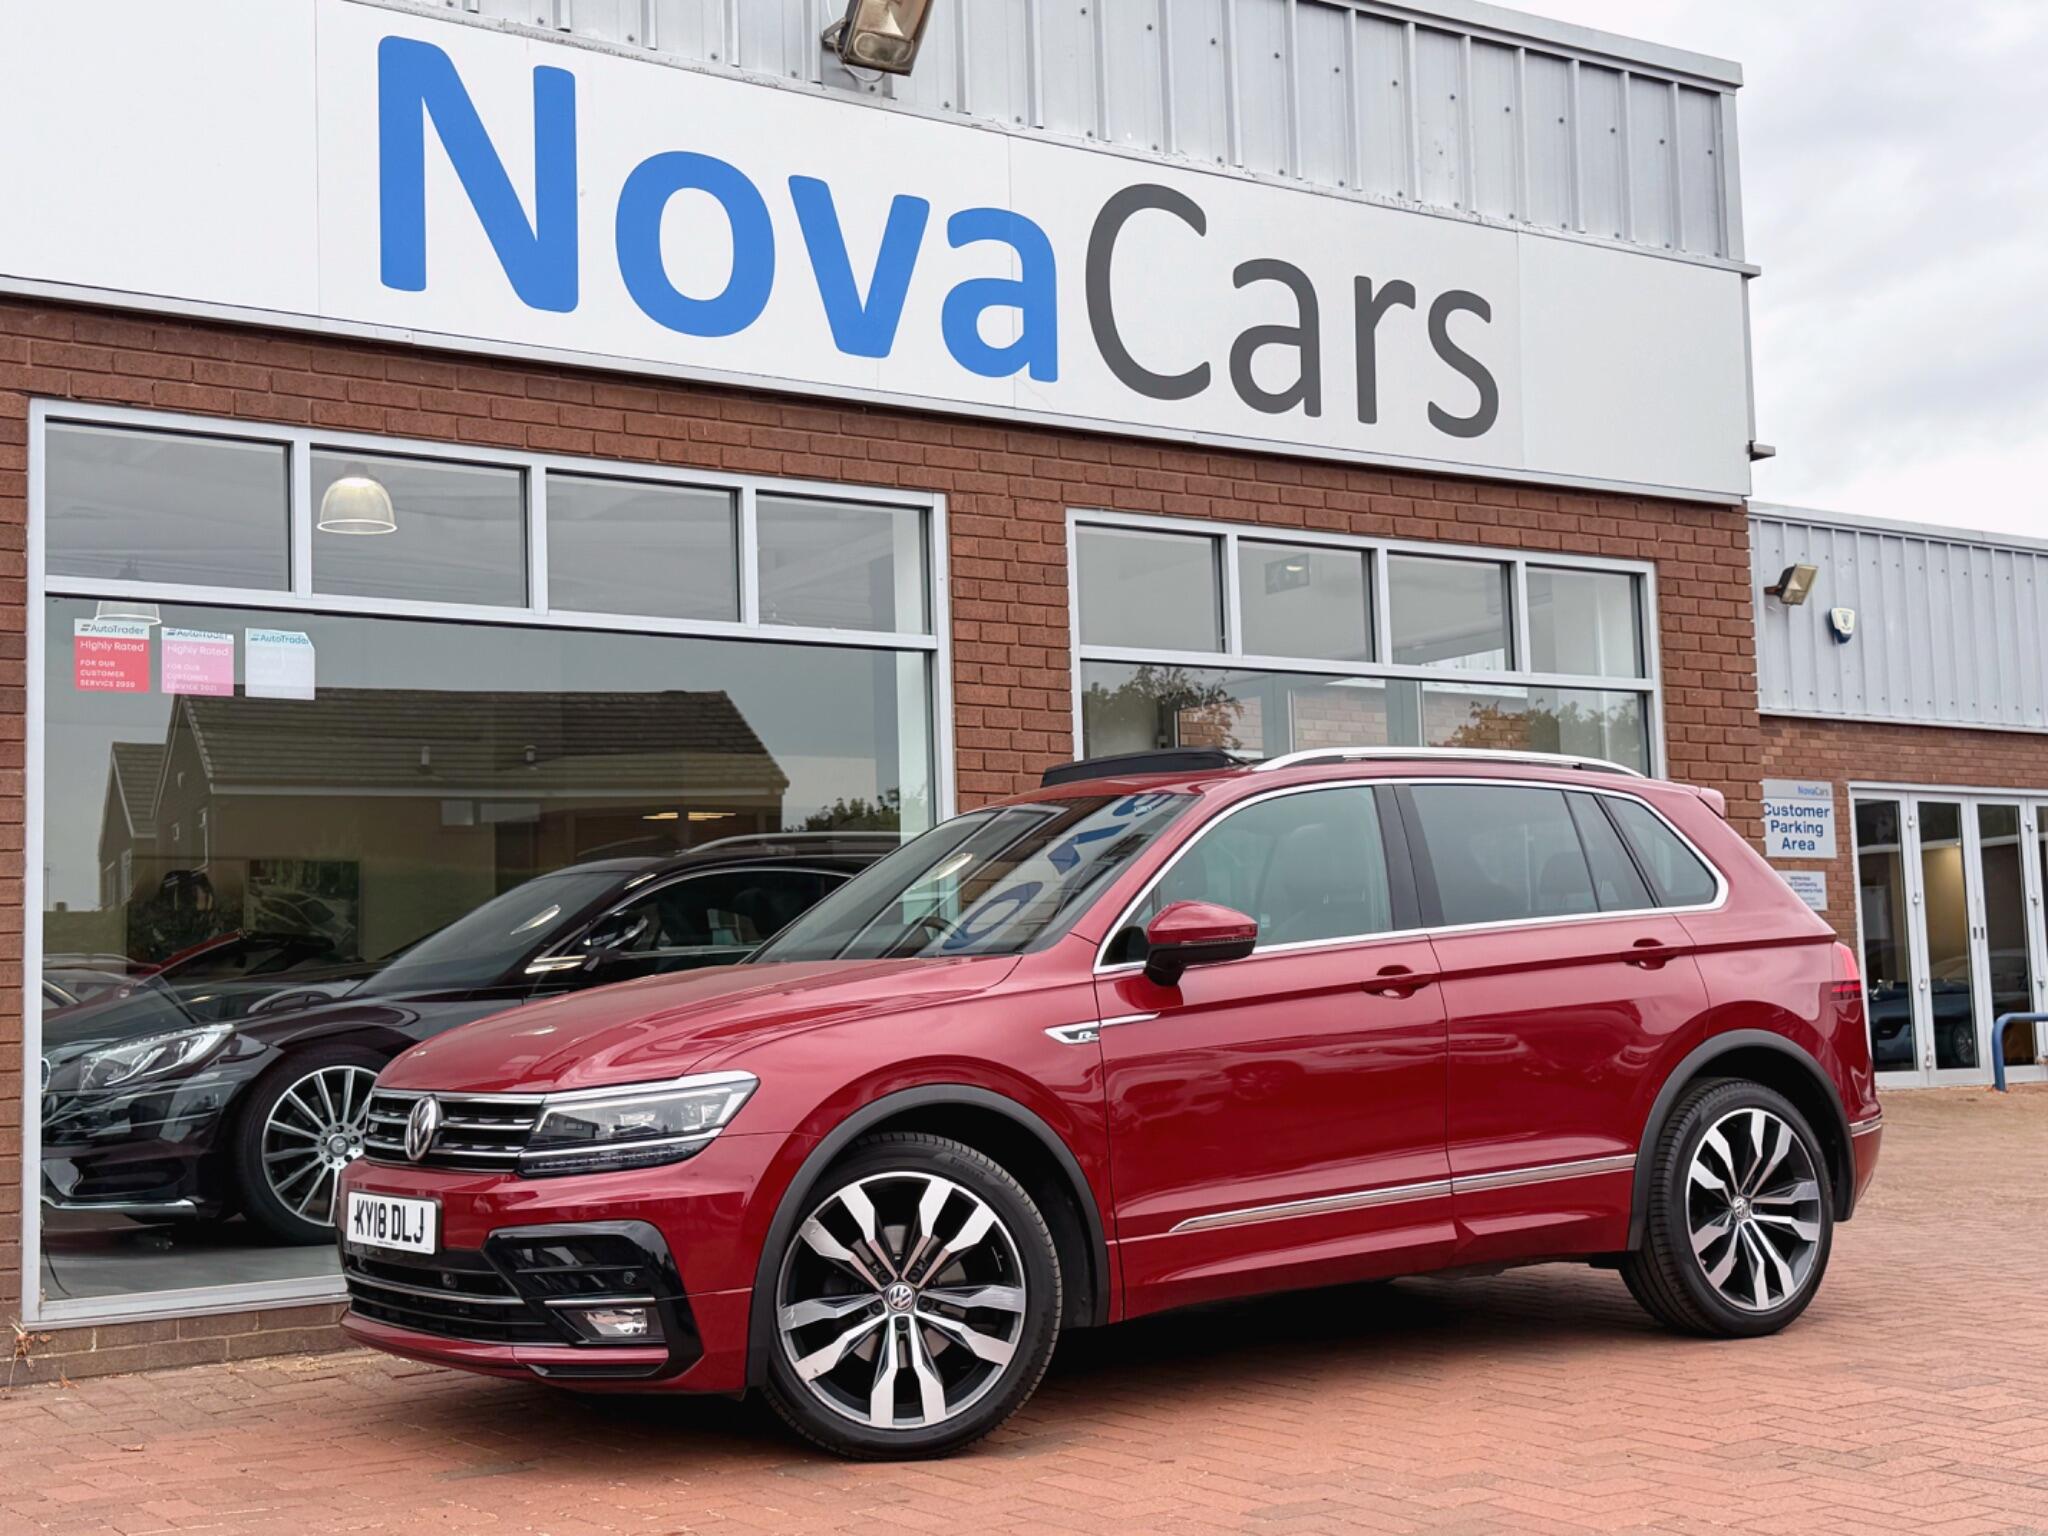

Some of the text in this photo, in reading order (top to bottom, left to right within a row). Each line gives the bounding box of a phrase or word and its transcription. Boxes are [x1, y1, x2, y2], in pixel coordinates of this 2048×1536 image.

[379, 37, 1498, 438] NovaCars
[90, 624, 145, 635] AutoTrader
[80, 639, 144, 653] Highly Rated
[80, 659, 116, 668] FOR OUR
[80, 669, 125, 678] CUSTOMER
[80, 679, 114, 688] SERVICE
[1763, 802, 1830, 818] Customer
[1770, 819, 1824, 838] Parking
[1782, 836, 1815, 851] Area
[391, 1203, 425, 1245] DLJ
